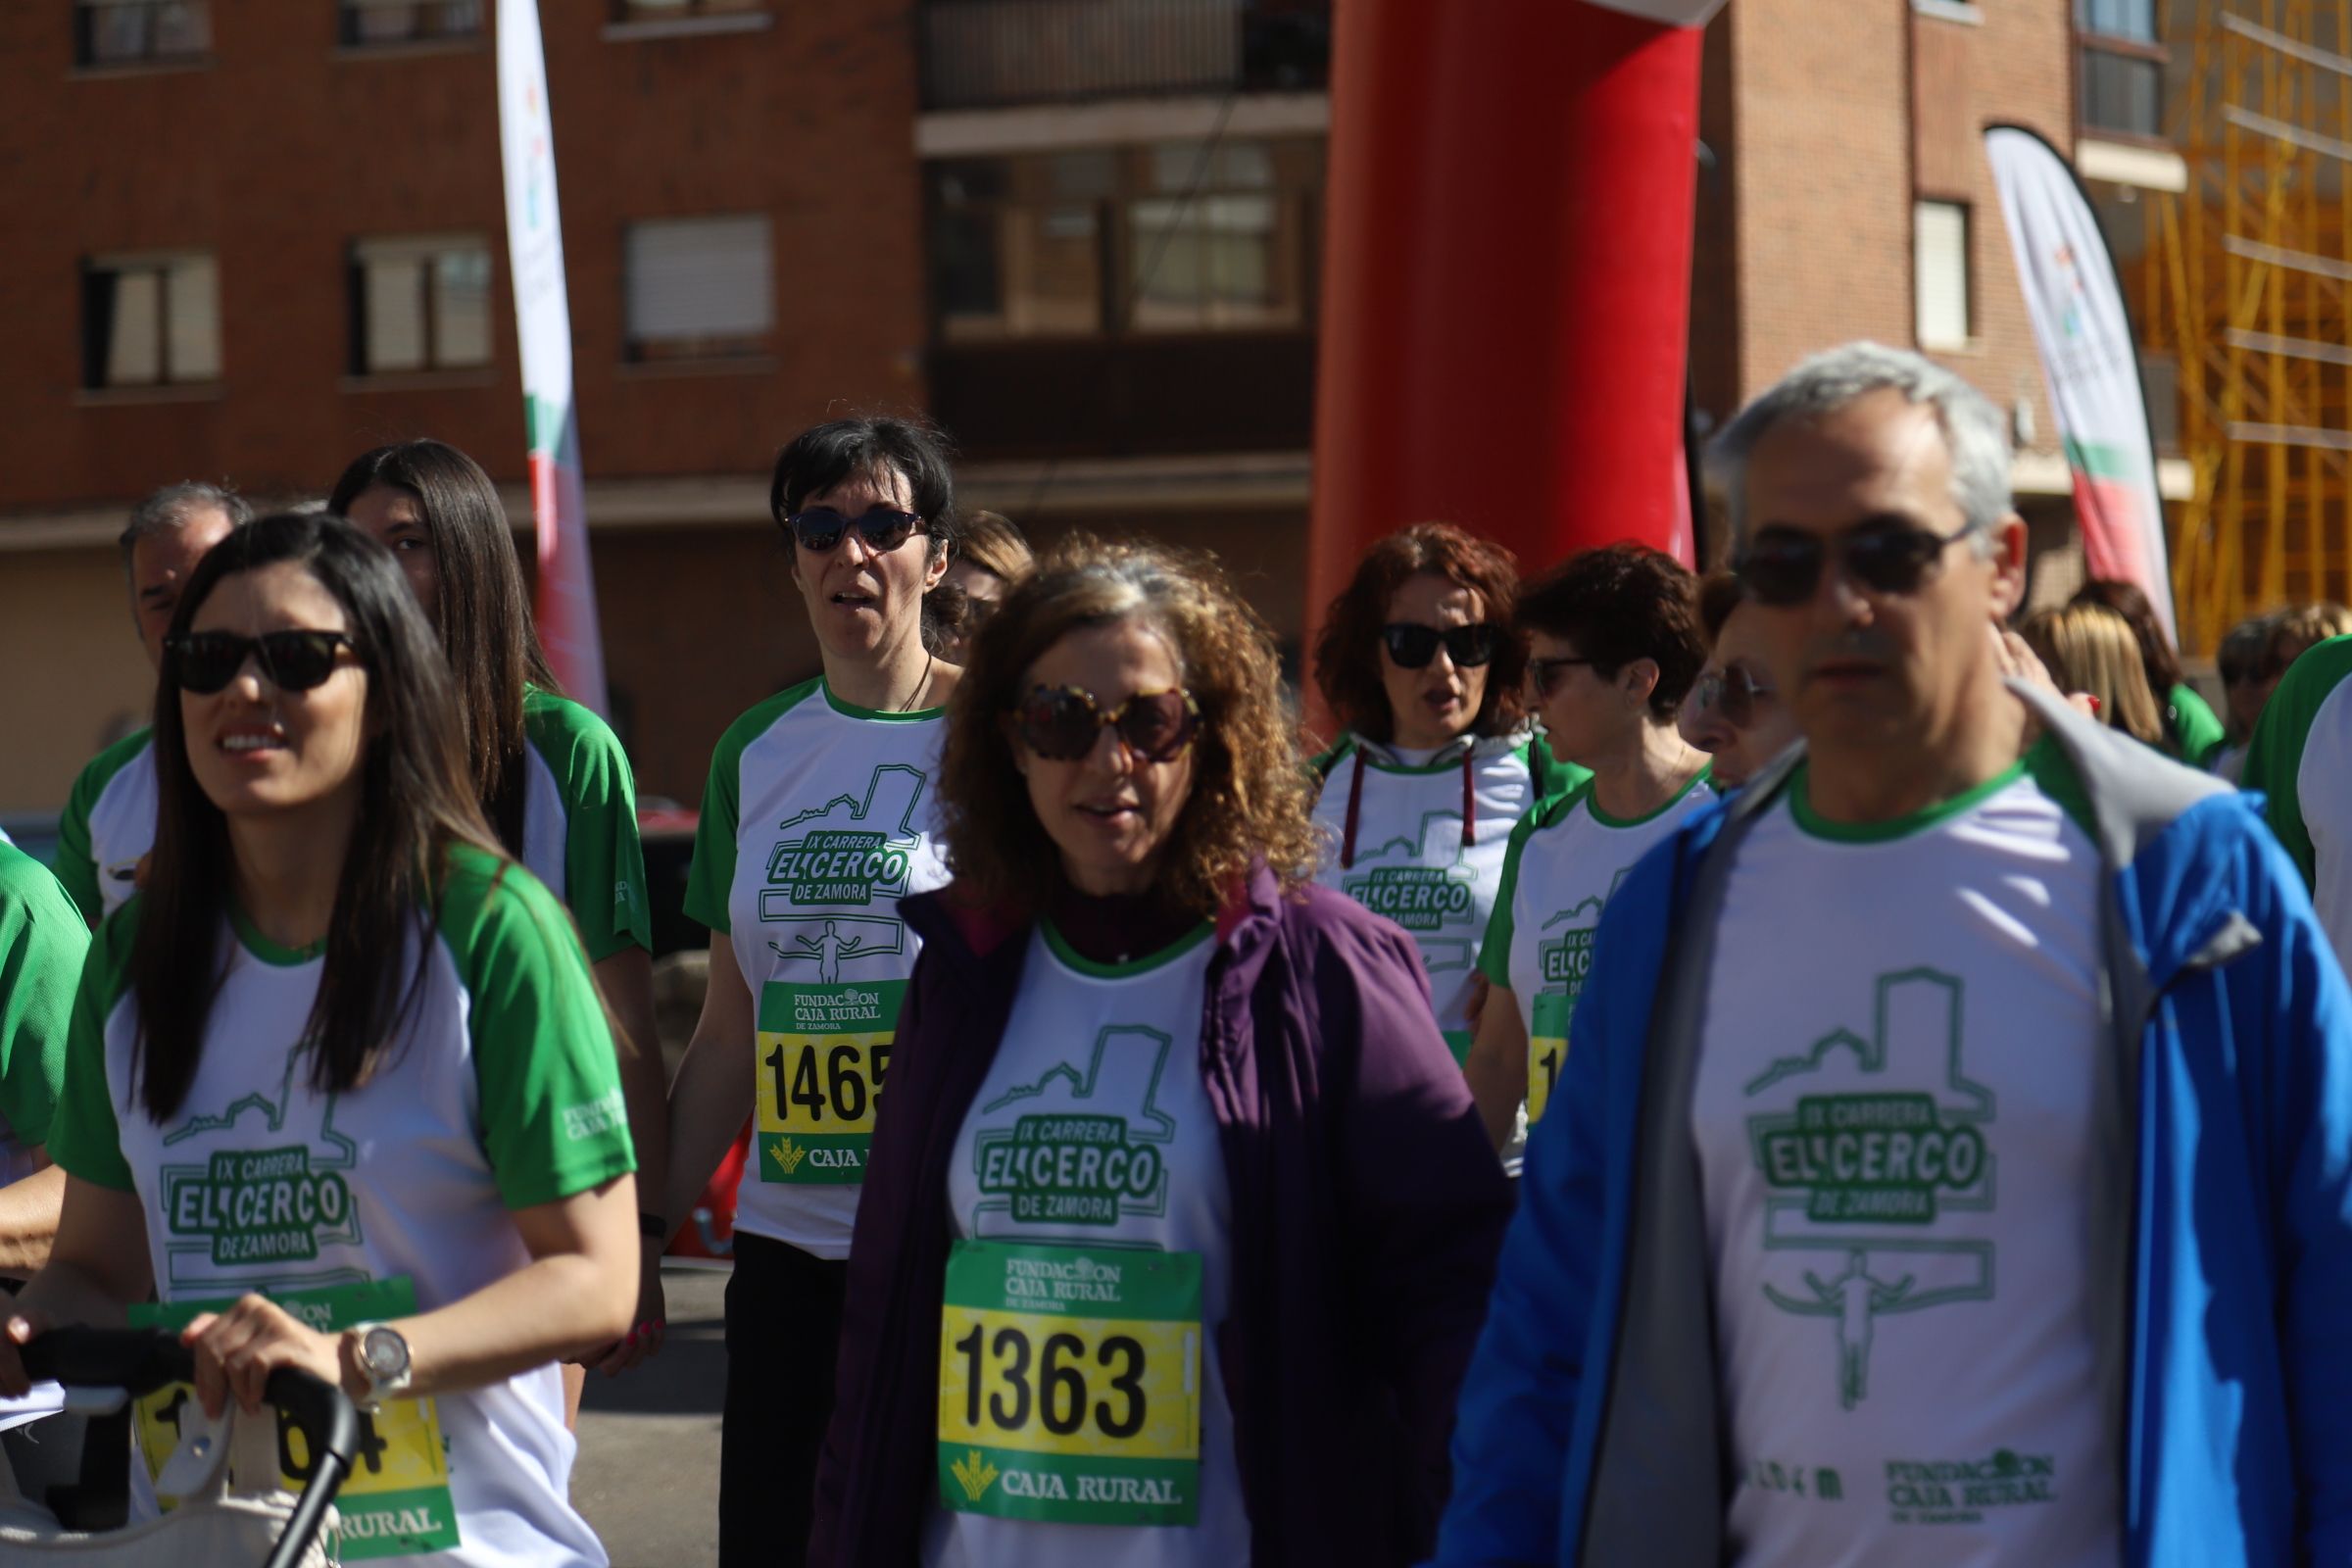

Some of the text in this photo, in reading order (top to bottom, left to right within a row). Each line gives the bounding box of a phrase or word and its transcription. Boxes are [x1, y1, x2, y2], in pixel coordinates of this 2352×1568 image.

[807, 836, 881, 849] IX CARRERA
[772, 852, 904, 880] EL CERCO
[795, 885, 867, 901] DE ZAMORA
[1382, 884, 1466, 909] CERCO
[795, 1006, 881, 1021] CAJA RURAL
[1019, 1121, 1121, 1144] IX CARRERA
[216, 1152, 306, 1180] IX CARRERA
[808, 1149, 861, 1168] CAJA
[983, 1146, 1154, 1192] EL CERCO
[1833, 1131, 1977, 1182] CERCO
[177, 1178, 341, 1229] EL CERCO
[1017, 1197, 1113, 1219] DE ZAMORA
[219, 1231, 311, 1259] DE ZAMORA
[1005, 1278, 1121, 1302] CAJA RURAL
[956, 1324, 1147, 1439] 1363
[1002, 1470, 1183, 1504] CAJA RURAL
[339, 1508, 442, 1540] RURAL
